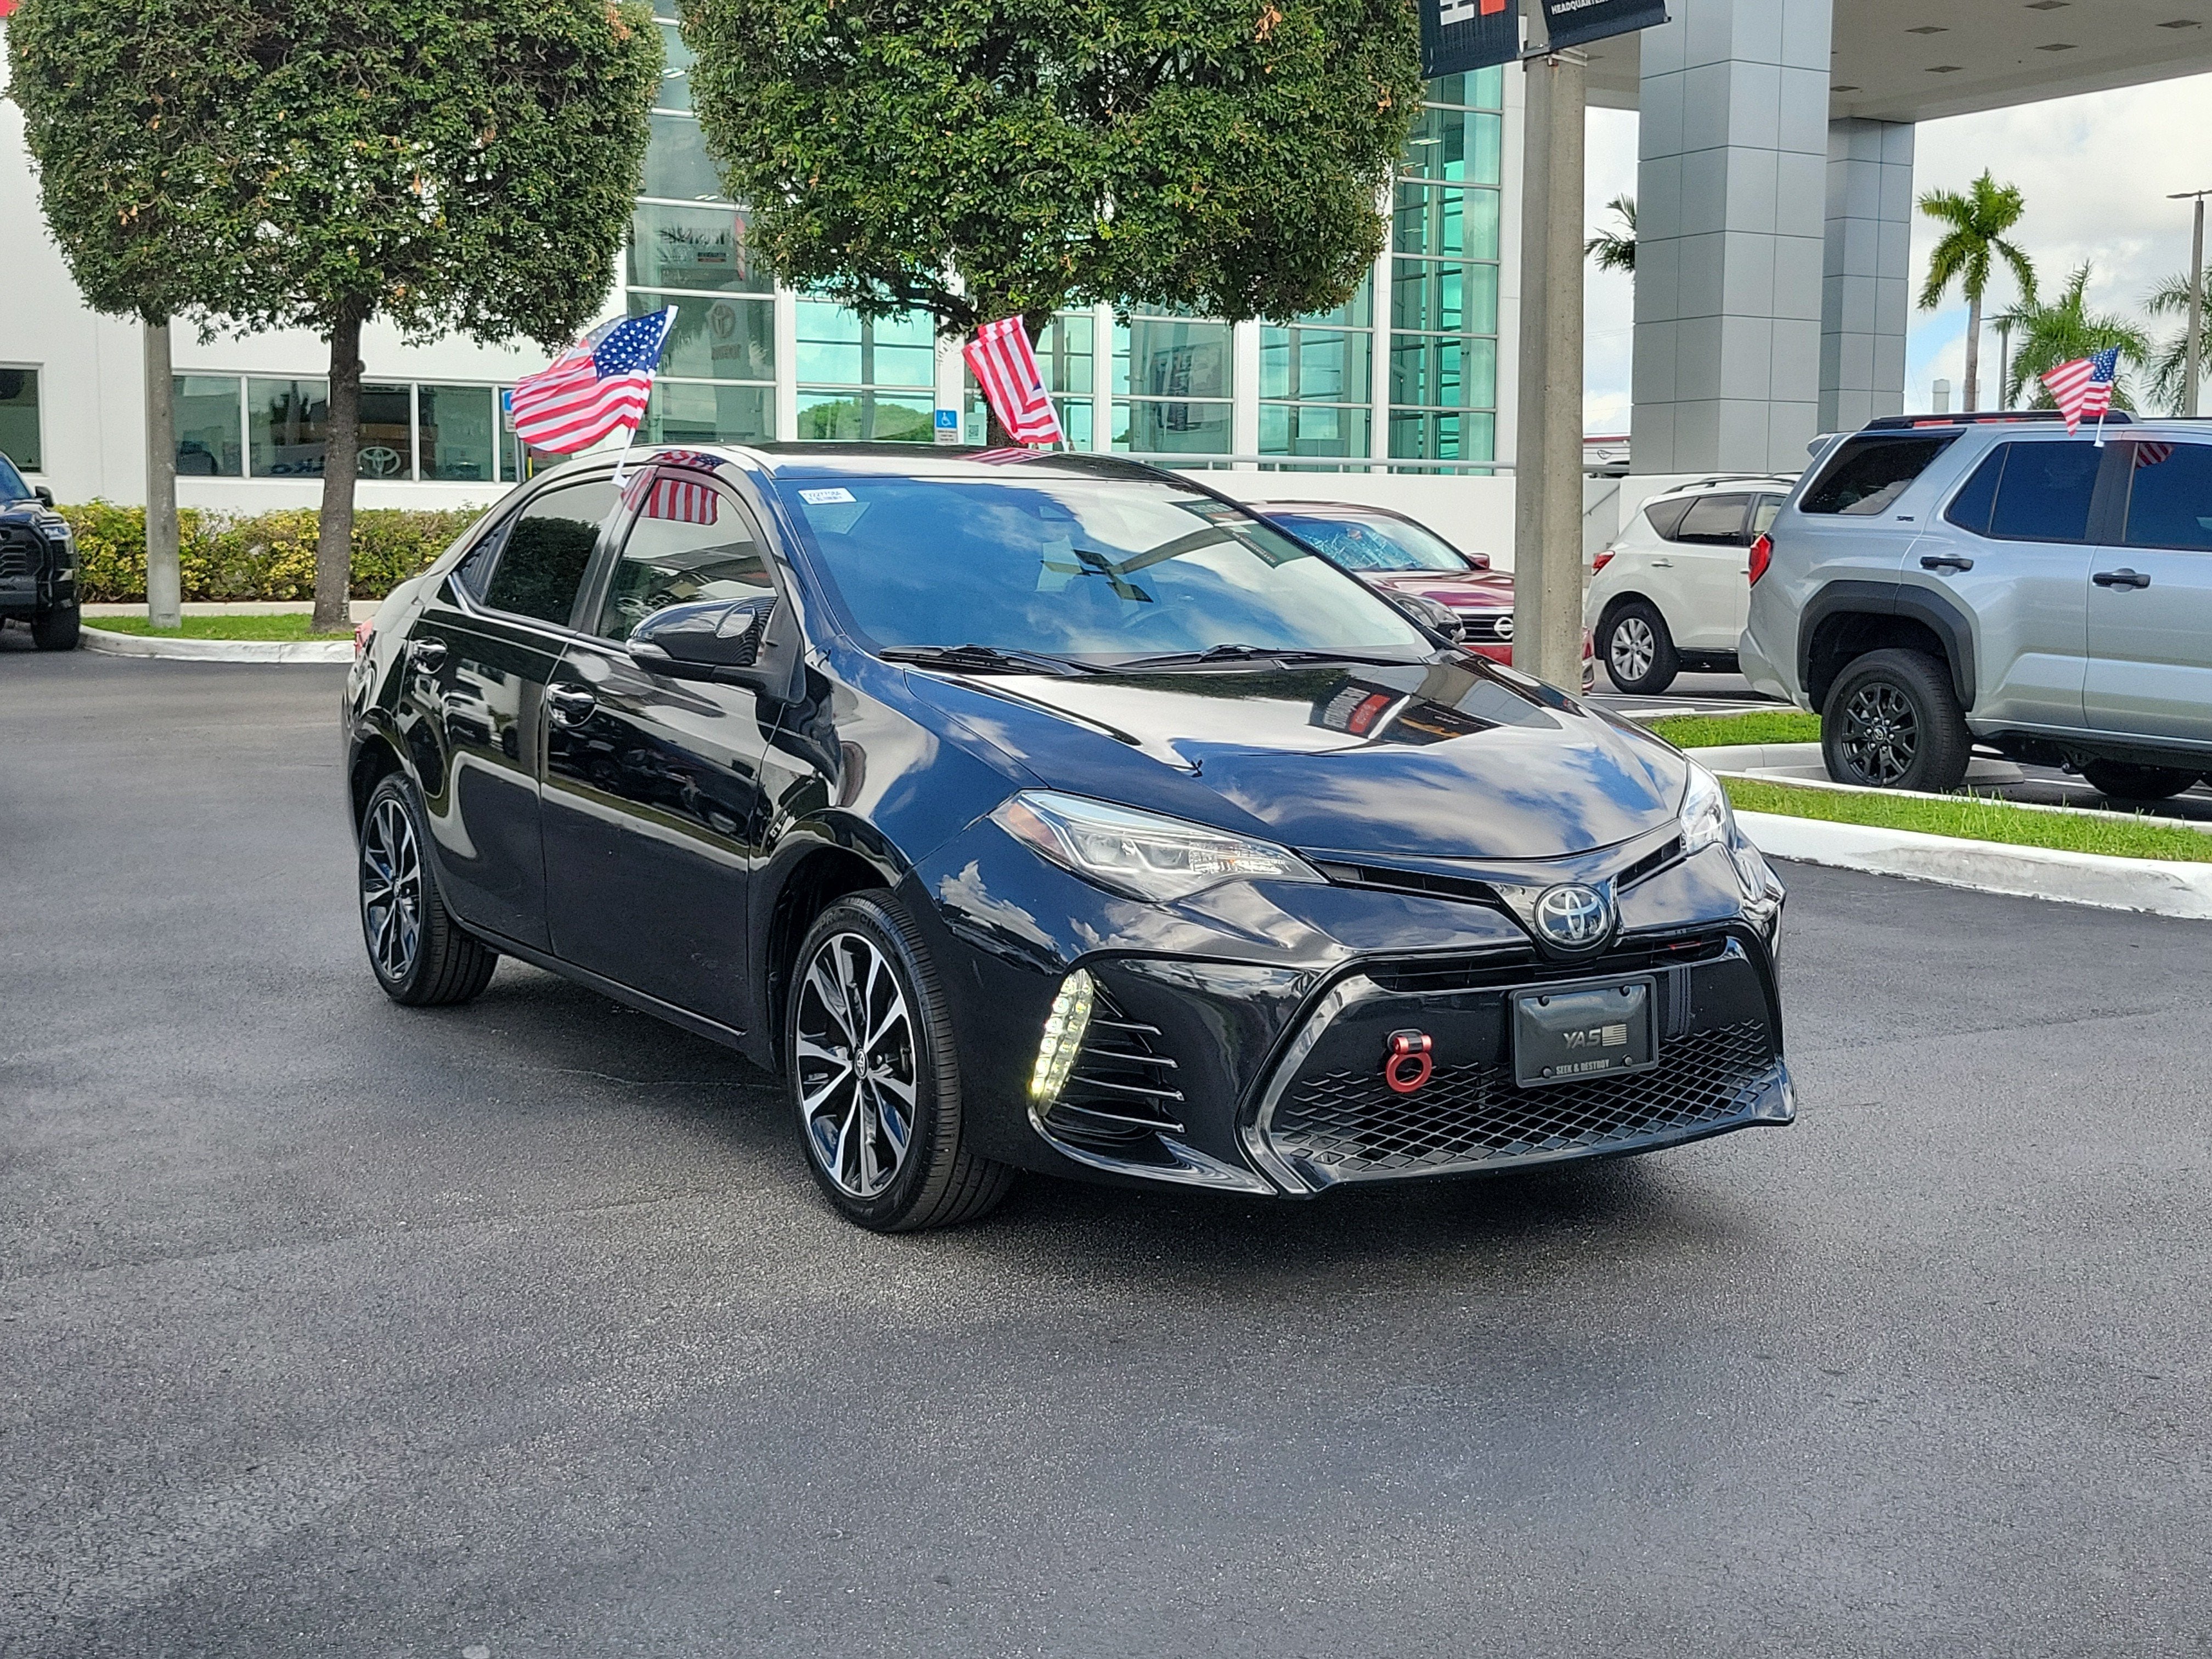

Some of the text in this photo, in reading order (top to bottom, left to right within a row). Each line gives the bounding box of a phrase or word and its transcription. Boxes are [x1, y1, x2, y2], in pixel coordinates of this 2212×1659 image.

[1550, 0, 1610, 15] HEADQUART
[1563, 1028, 1601, 1049] YAS
[1556, 1059, 1609, 1075] SEEK & DESTROY
